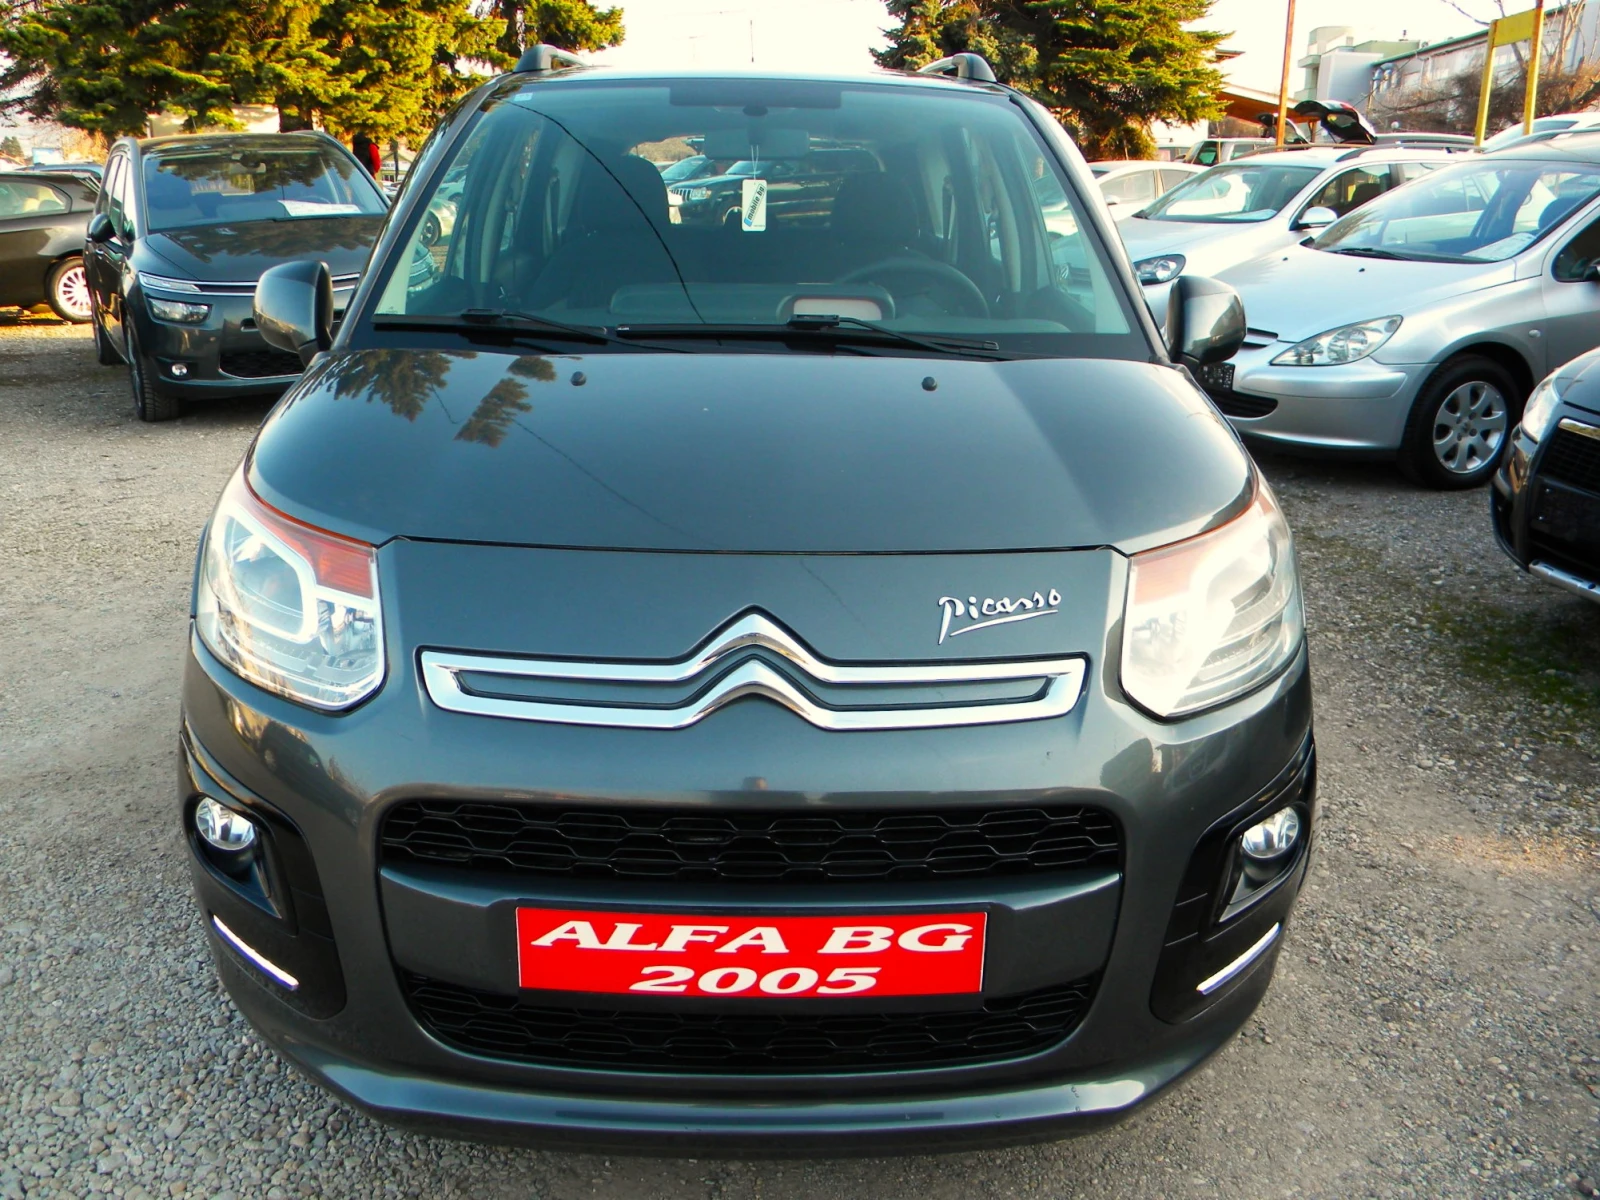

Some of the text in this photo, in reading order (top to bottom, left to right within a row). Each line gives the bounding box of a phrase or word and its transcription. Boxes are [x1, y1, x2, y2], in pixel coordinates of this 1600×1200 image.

[531, 919, 974, 954] ALFA BG
[628, 964, 883, 995] 2005
